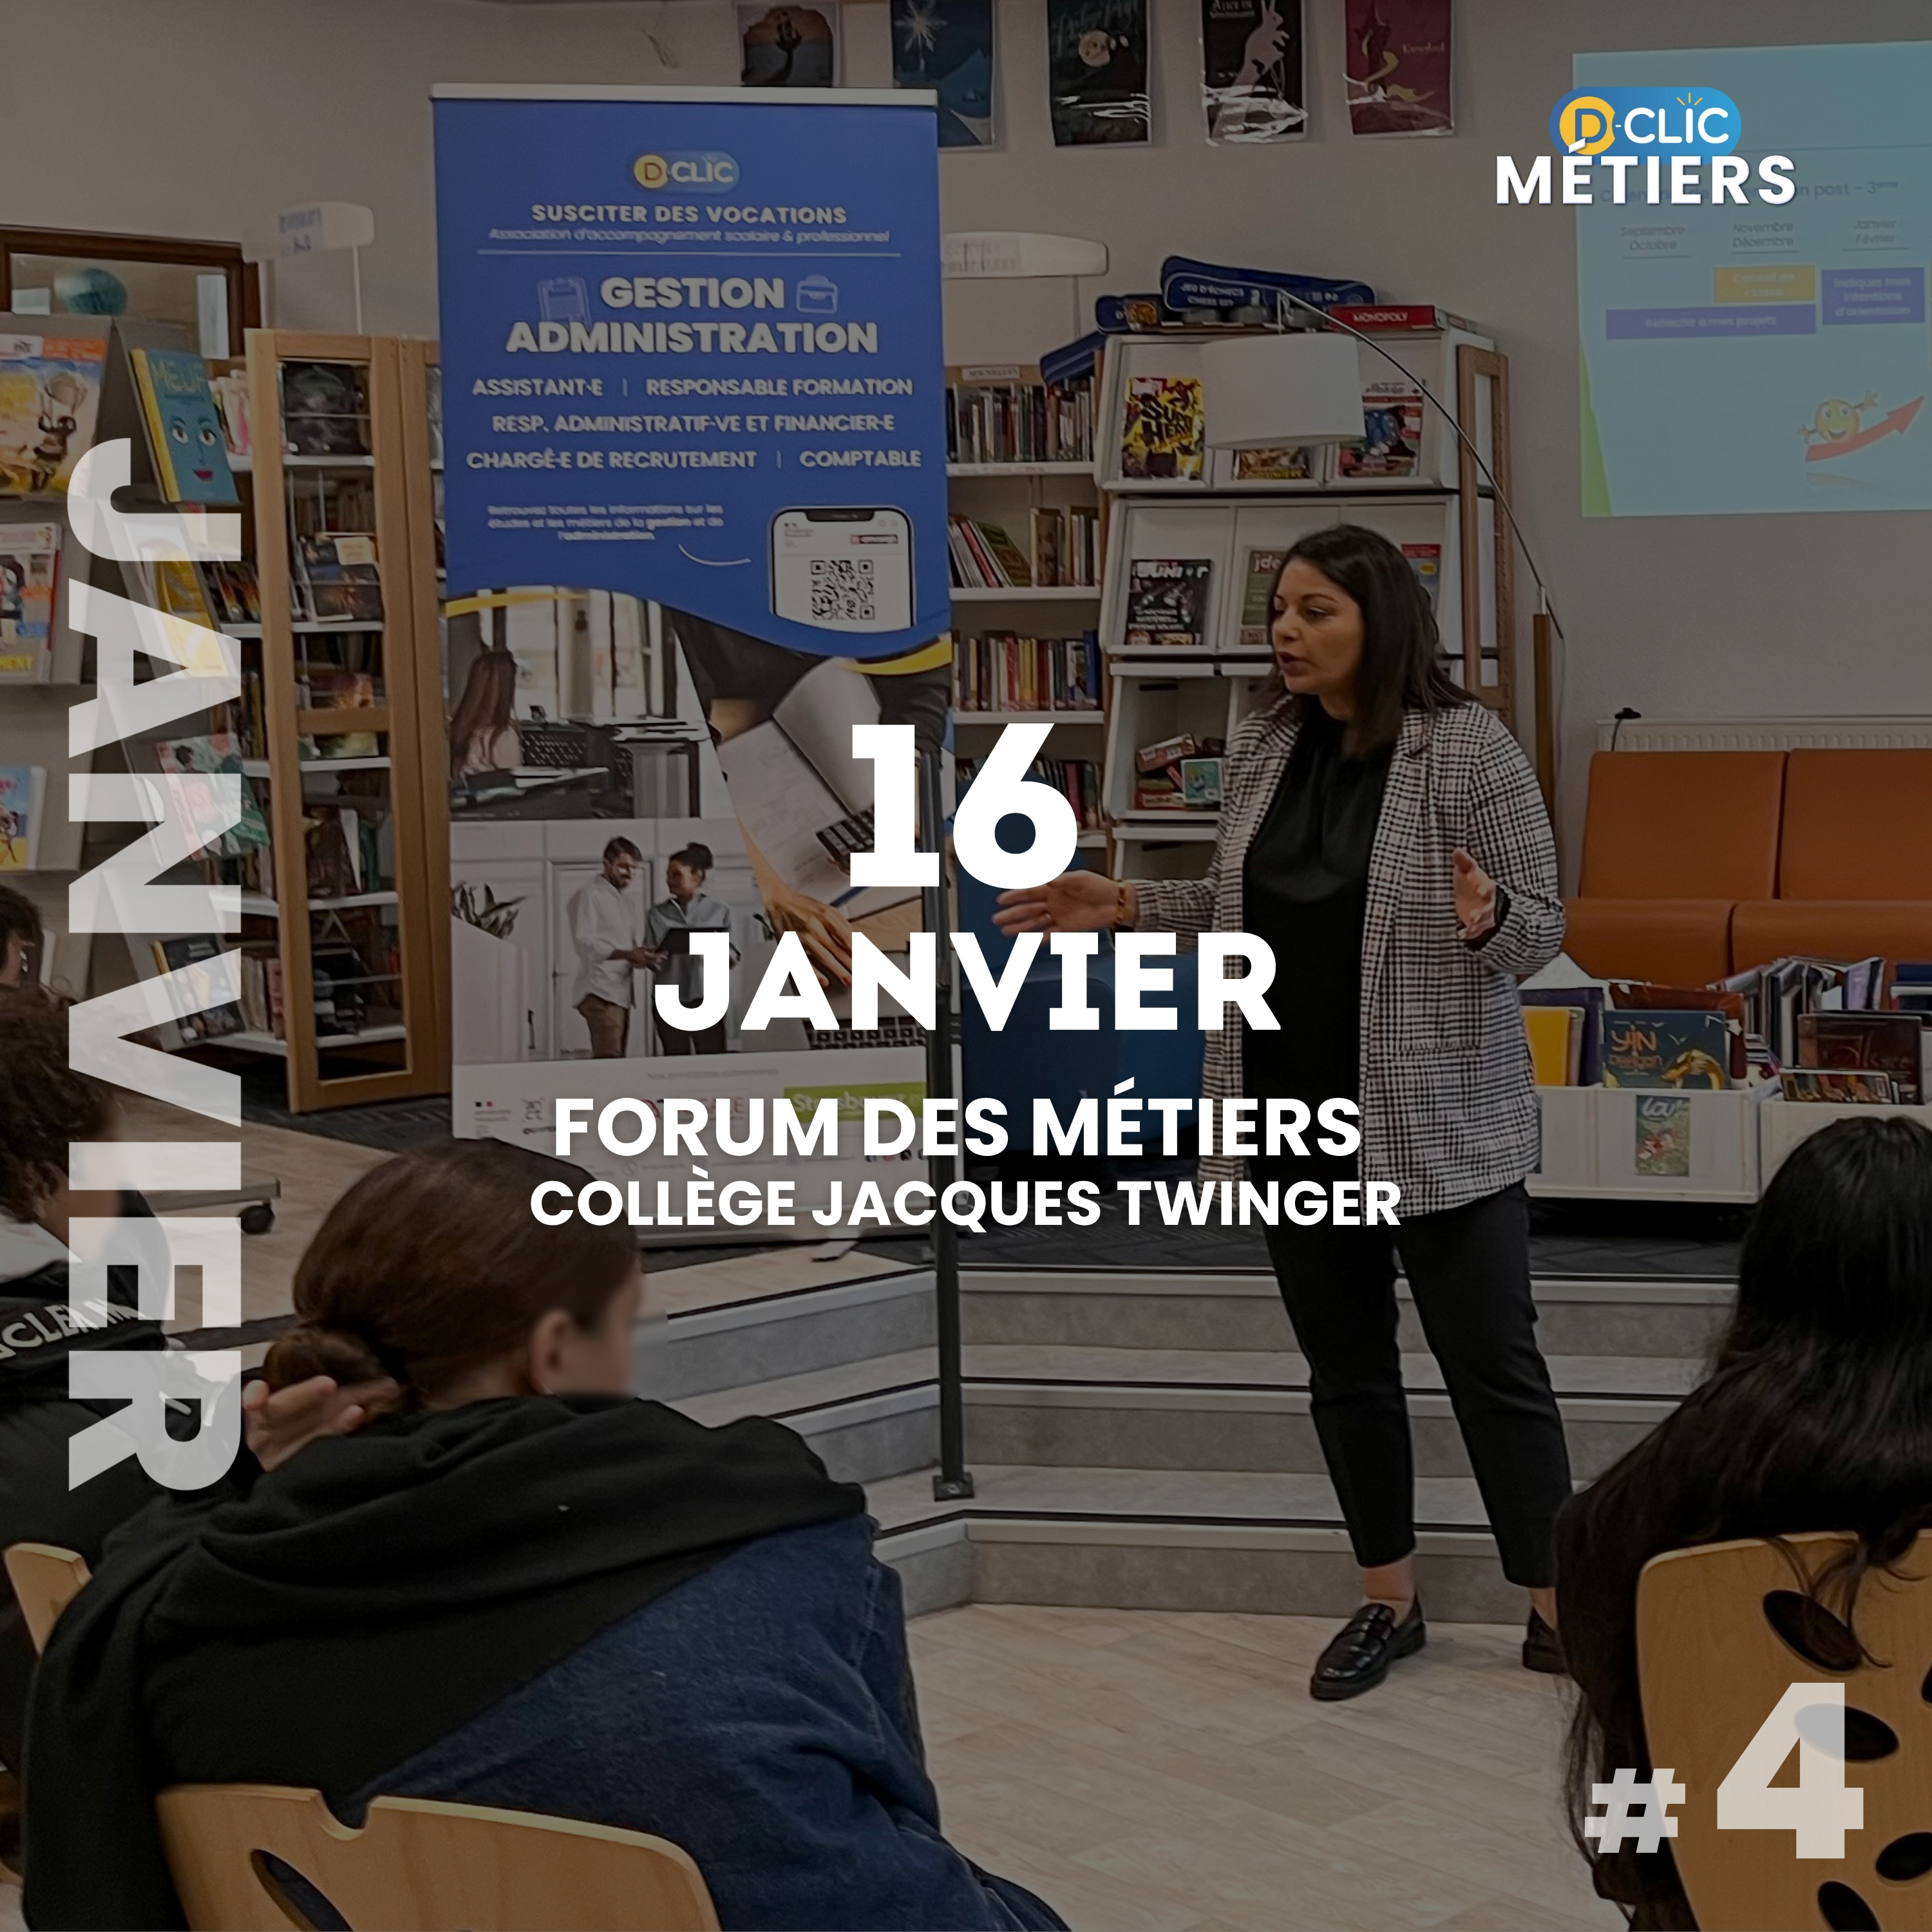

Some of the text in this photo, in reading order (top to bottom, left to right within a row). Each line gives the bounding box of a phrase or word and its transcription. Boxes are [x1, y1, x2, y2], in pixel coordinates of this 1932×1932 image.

[1814, 183, 1849, 200] post
[532, 204, 847, 224] SUSCITER DES VOCATIONS
[1733, 222, 1794, 234] Novembre
[600, 277, 784, 308] GESTION
[506, 321, 878, 353] ADMINISTRATION
[646, 378, 788, 396] RESPONSABLE
[793, 378, 913, 396] FORMATION
[746, 415, 770, 433] ET
[576, 451, 604, 469] DE
[609, 451, 758, 469] RECRUTEMENT
[799, 450, 922, 468] COMPTABLE
